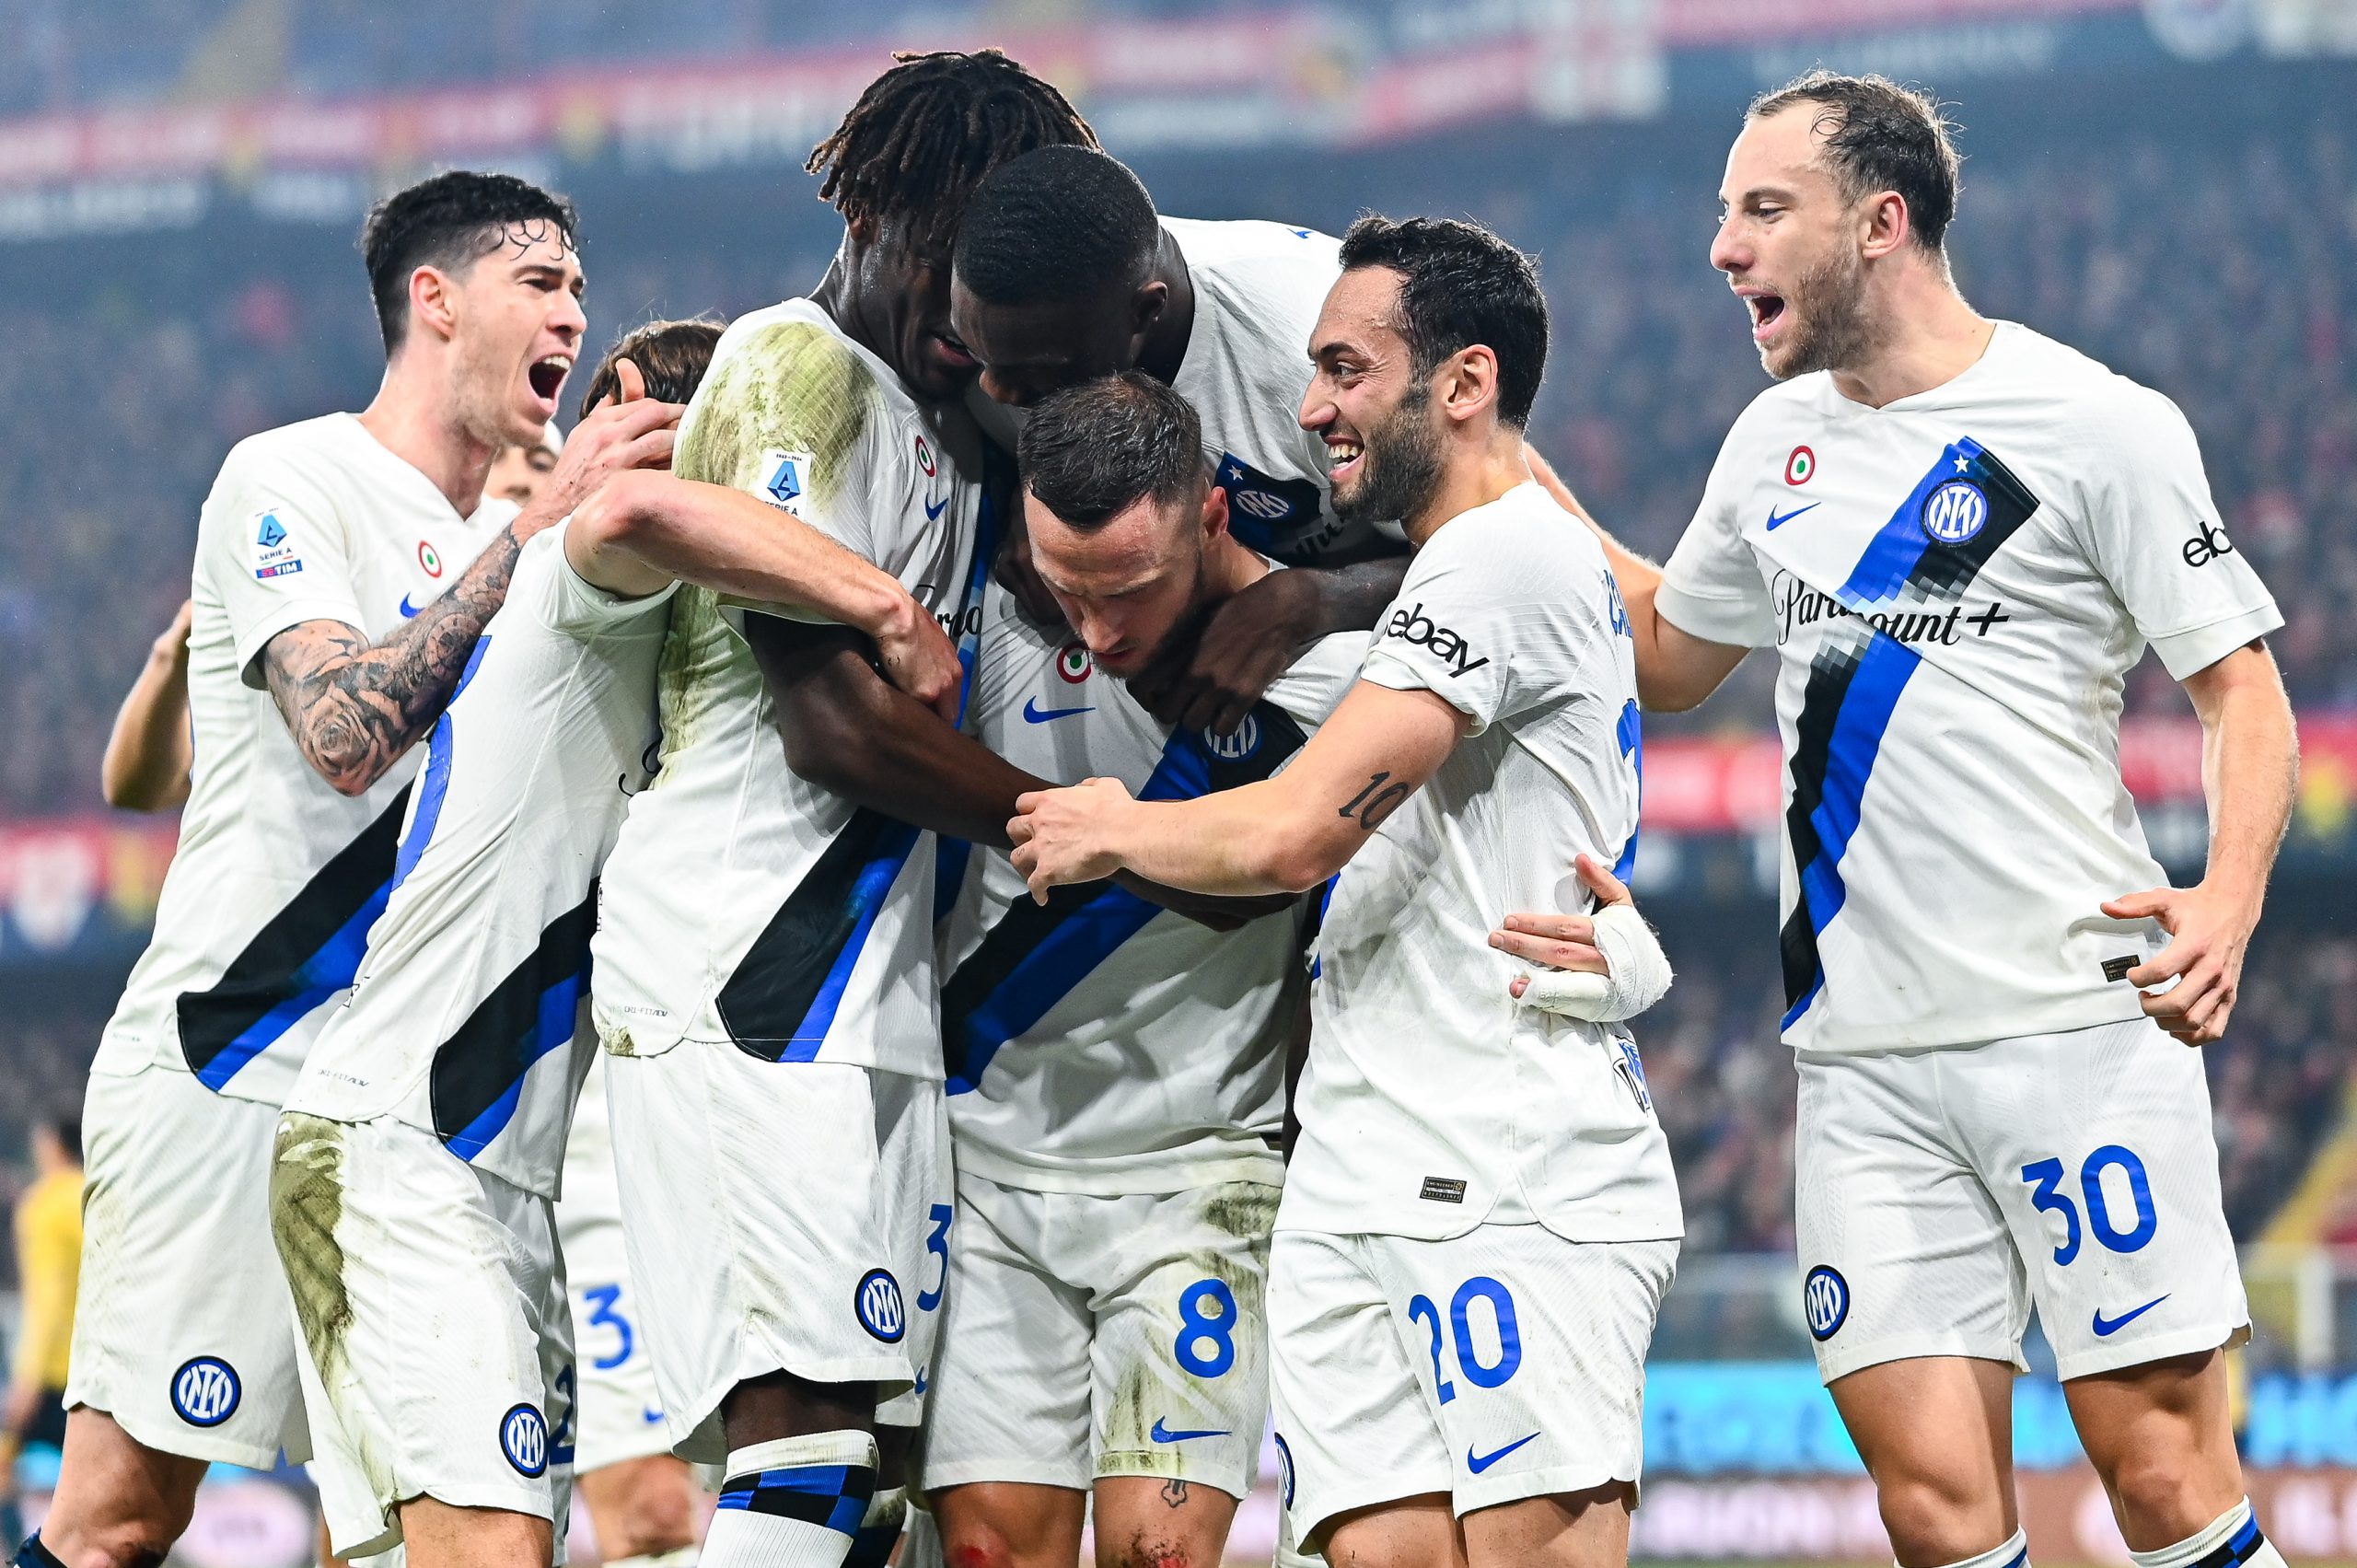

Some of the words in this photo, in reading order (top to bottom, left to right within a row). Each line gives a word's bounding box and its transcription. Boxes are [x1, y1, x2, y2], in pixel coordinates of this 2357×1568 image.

[259, 549, 284, 561] SERIE
[274, 563, 297, 575] TIM
[2183, 520, 2233, 567] eb
[1387, 602, 1491, 679] ebay
[1771, 568, 2011, 646] Paraount+
[1338, 771, 1409, 830] 10
[2021, 1144, 2157, 1266] 30
[584, 1283, 633, 1369] 3
[1174, 1278, 1237, 1378] 8
[1408, 1276, 1522, 1406] 20
